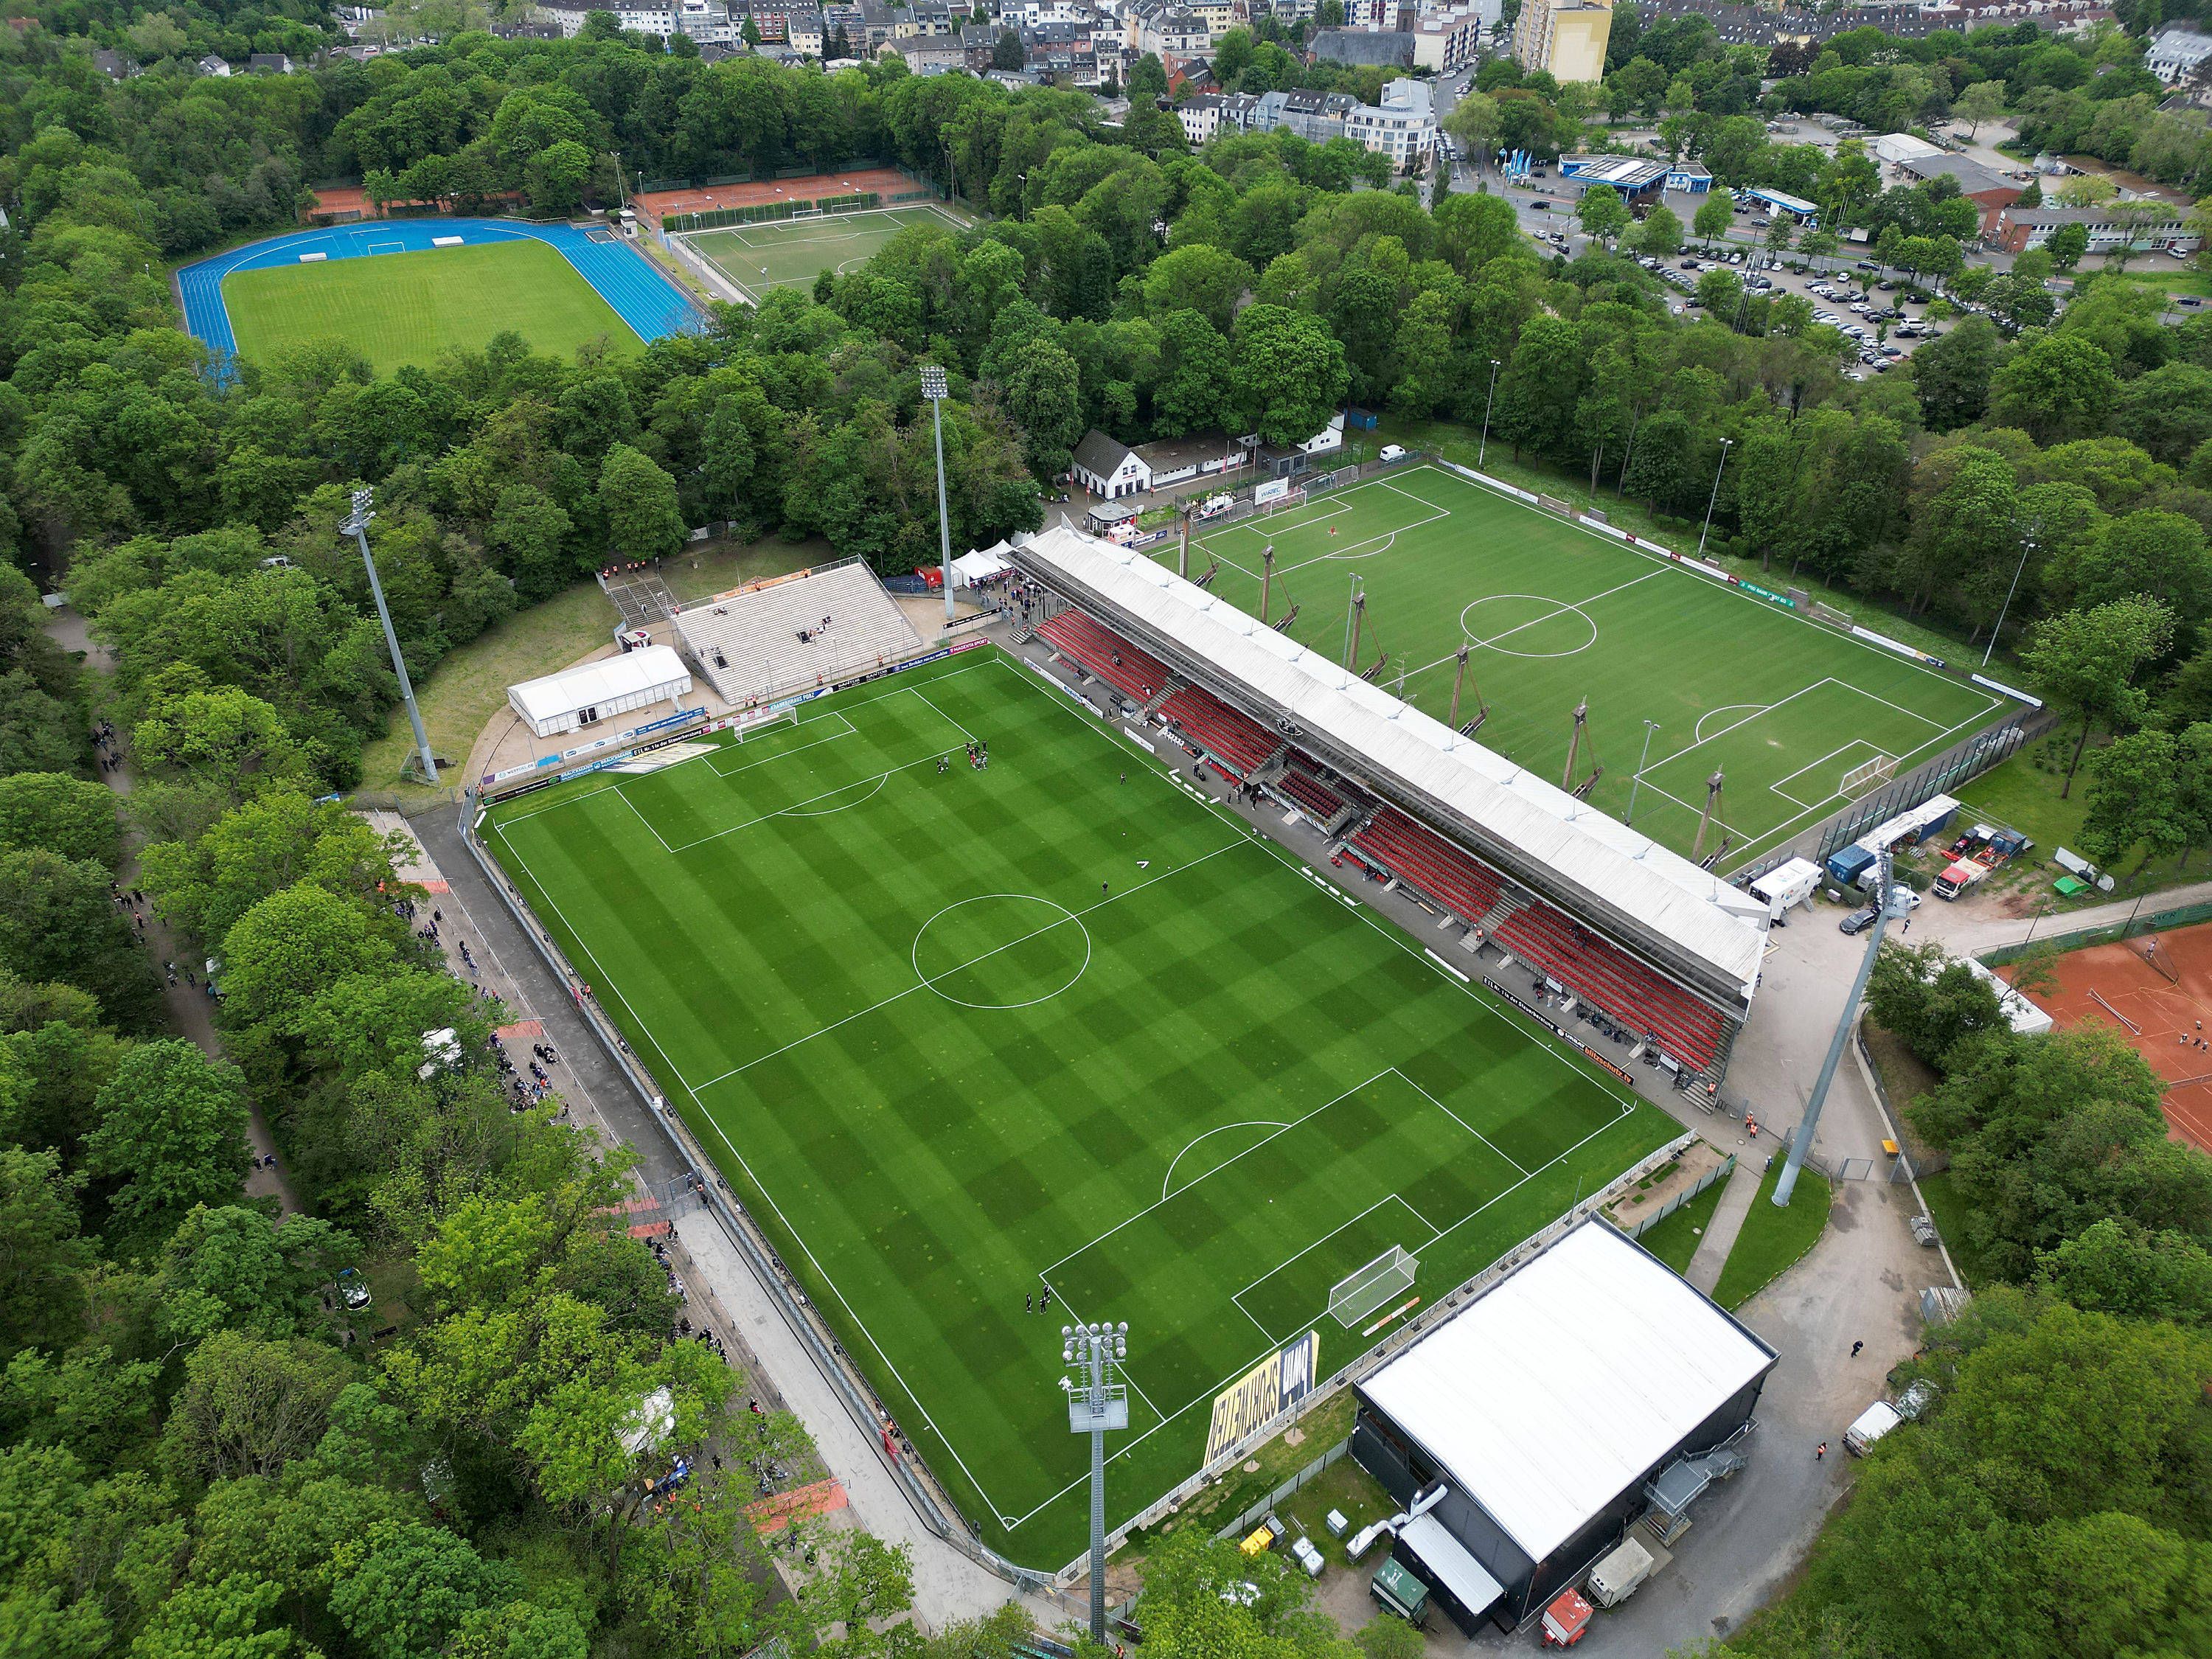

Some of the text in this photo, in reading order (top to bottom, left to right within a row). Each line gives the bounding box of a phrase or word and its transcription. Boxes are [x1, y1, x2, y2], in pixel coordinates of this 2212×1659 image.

[954, 641, 974, 652] MAGENTA
[974, 639, 987, 647] SPORT
[803, 692, 815, 701] PORZ
[1484, 977, 1494, 989] ETL
[1509, 996, 1518, 1004] der
[1518, 1001, 1554, 1030] Steuerberatung
[1585, 1046, 1632, 1083] blitzschutz.tv
[1203, 1338, 1309, 1468] bwin SPORTWETTEN
